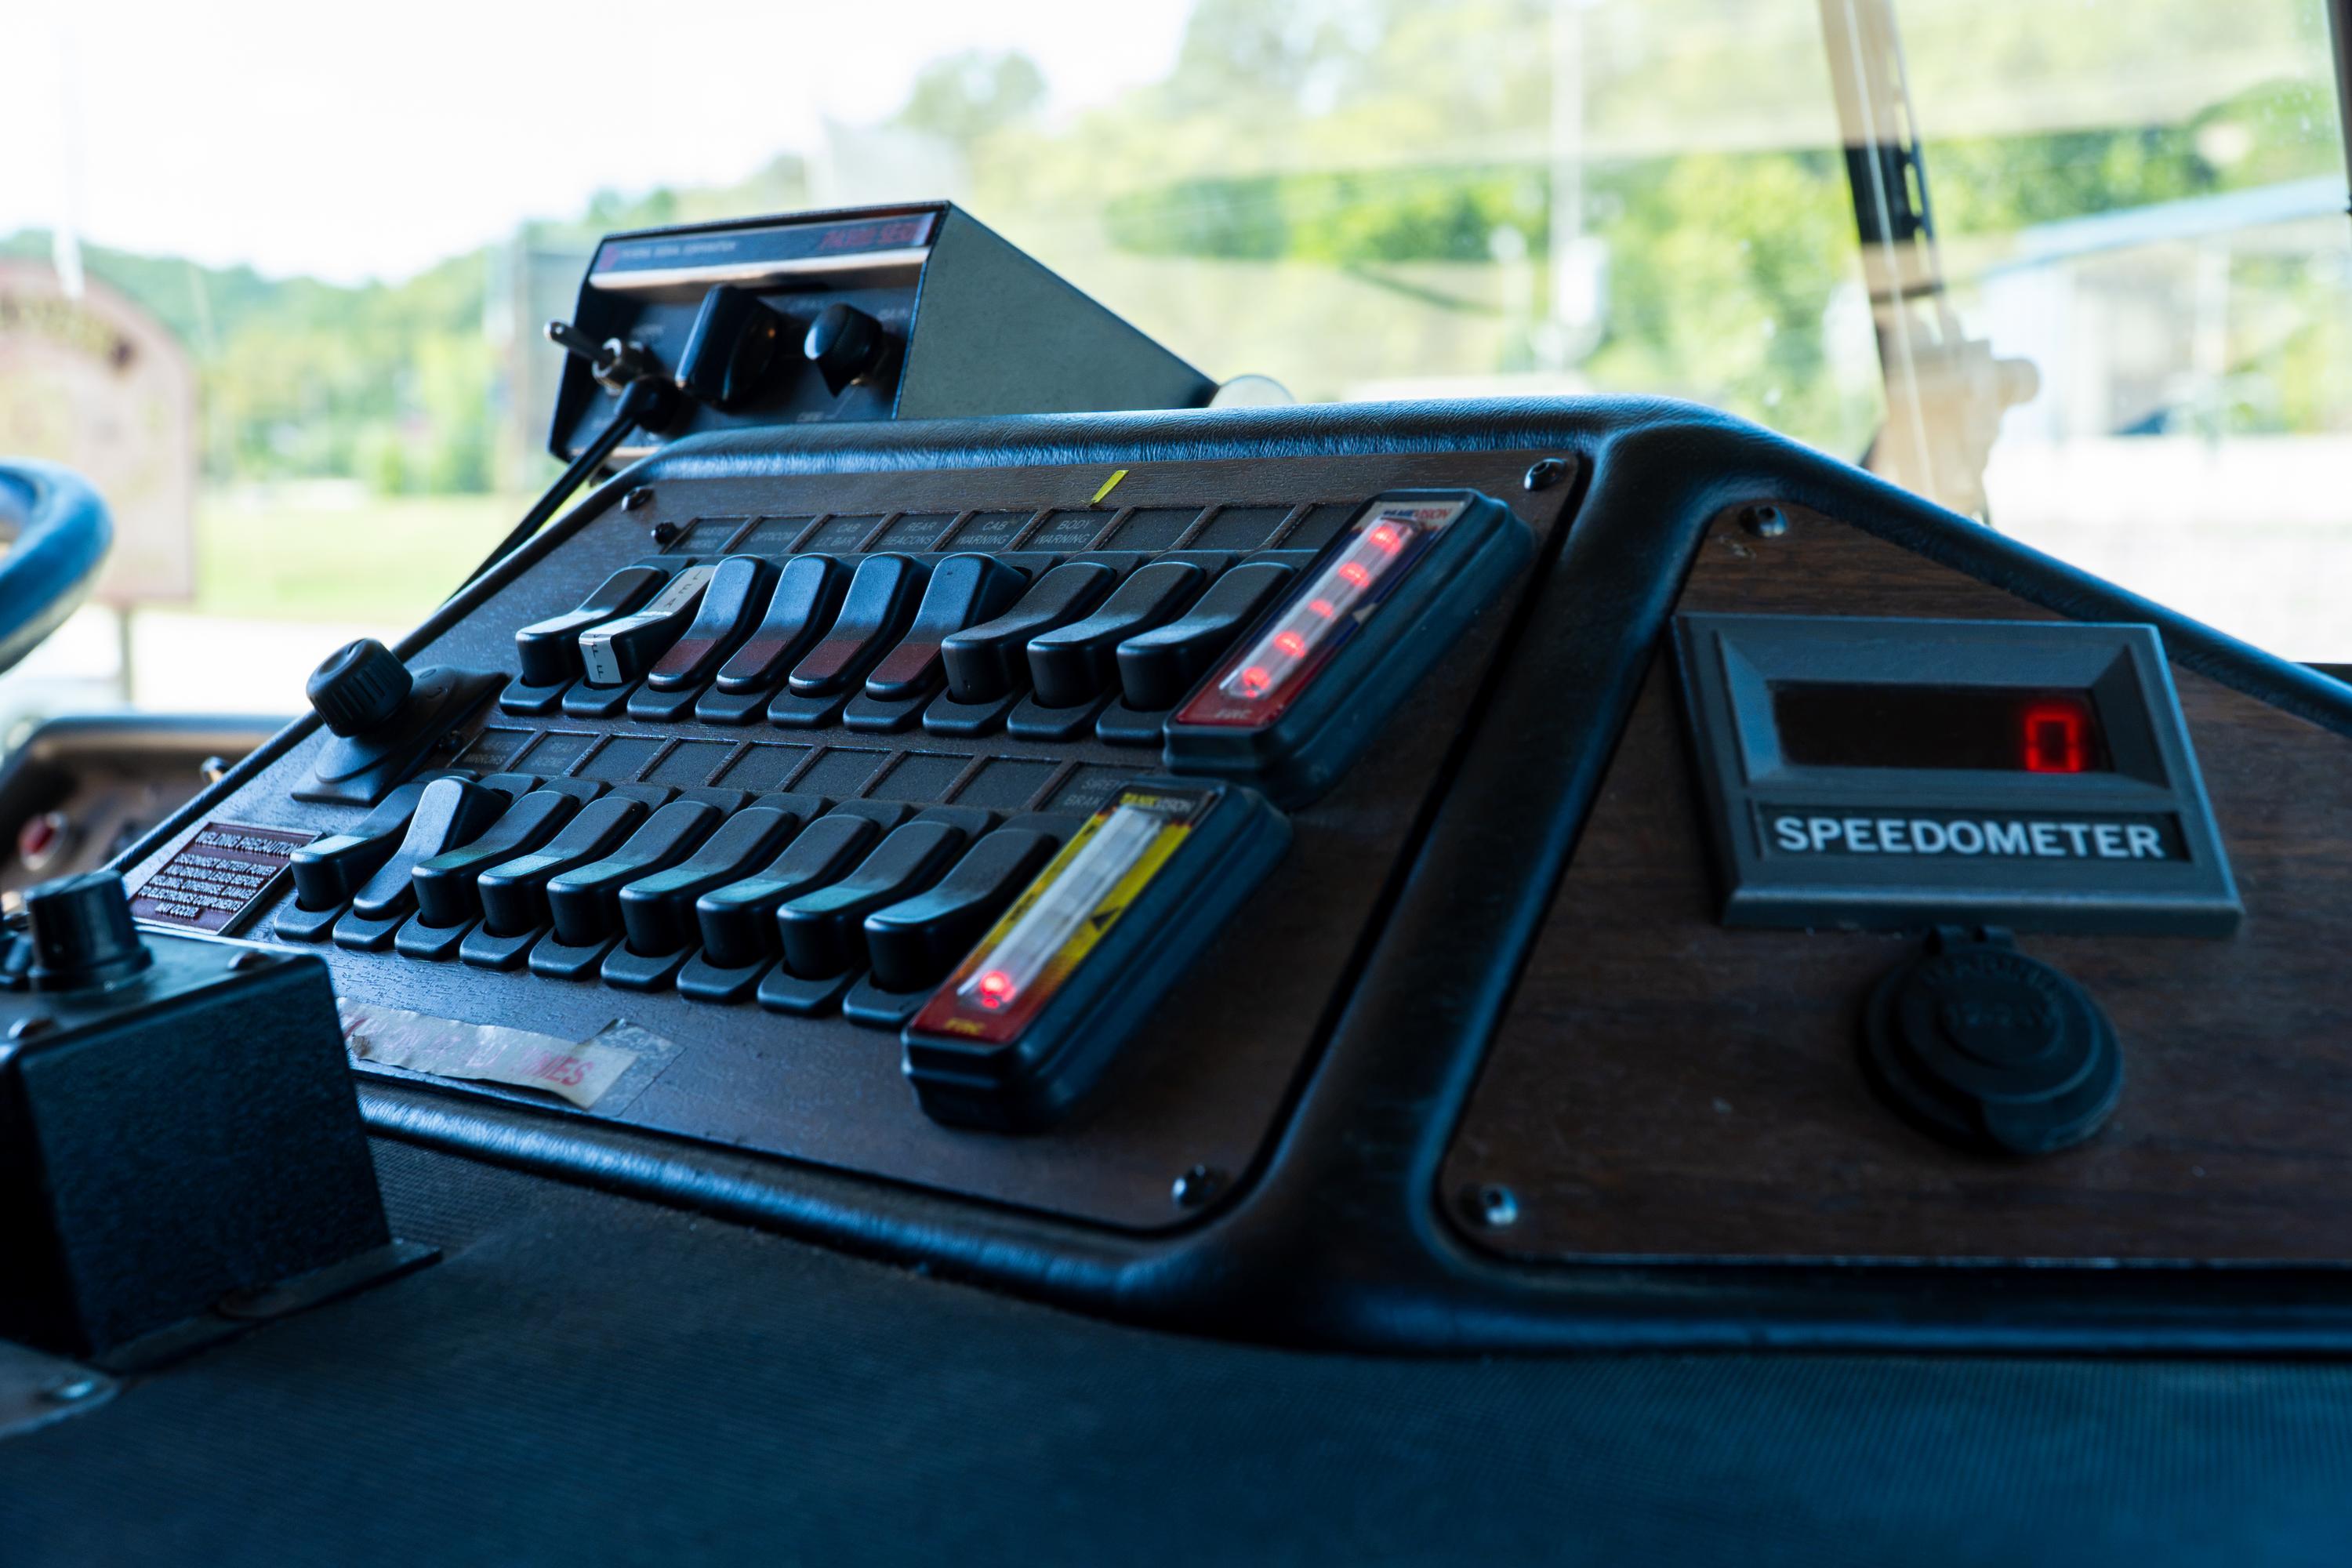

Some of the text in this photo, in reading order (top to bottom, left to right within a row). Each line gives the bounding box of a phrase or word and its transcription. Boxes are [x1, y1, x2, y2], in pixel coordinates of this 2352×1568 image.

[837, 523, 861, 533] CAB
[904, 521, 937, 532] REAR
[982, 520, 1009, 531] CAB
[1056, 519, 1094, 530] BODY
[750, 531, 797, 543] OPTICOM
[831, 536, 856, 547] BAR
[881, 535, 935, 546] BEACONS
[956, 534, 1009, 546] WARNING
[1034, 533, 1091, 546] WARNING
[2026, 712, 2081, 773] 0
[195, 831, 241, 848] WELDING
[1773, 816, 2165, 858] SPEEDOMETER
[173, 853, 278, 877] DISCONNECT BATTERY POWER
[208, 870, 234, 883] LEADS
[230, 873, 264, 888] BEFORE
[137, 885, 152, 896] TO
[192, 895, 245, 912] COMPONENTS
[221, 885, 257, 900] DAMAGE
[154, 902, 176, 913] MAY
